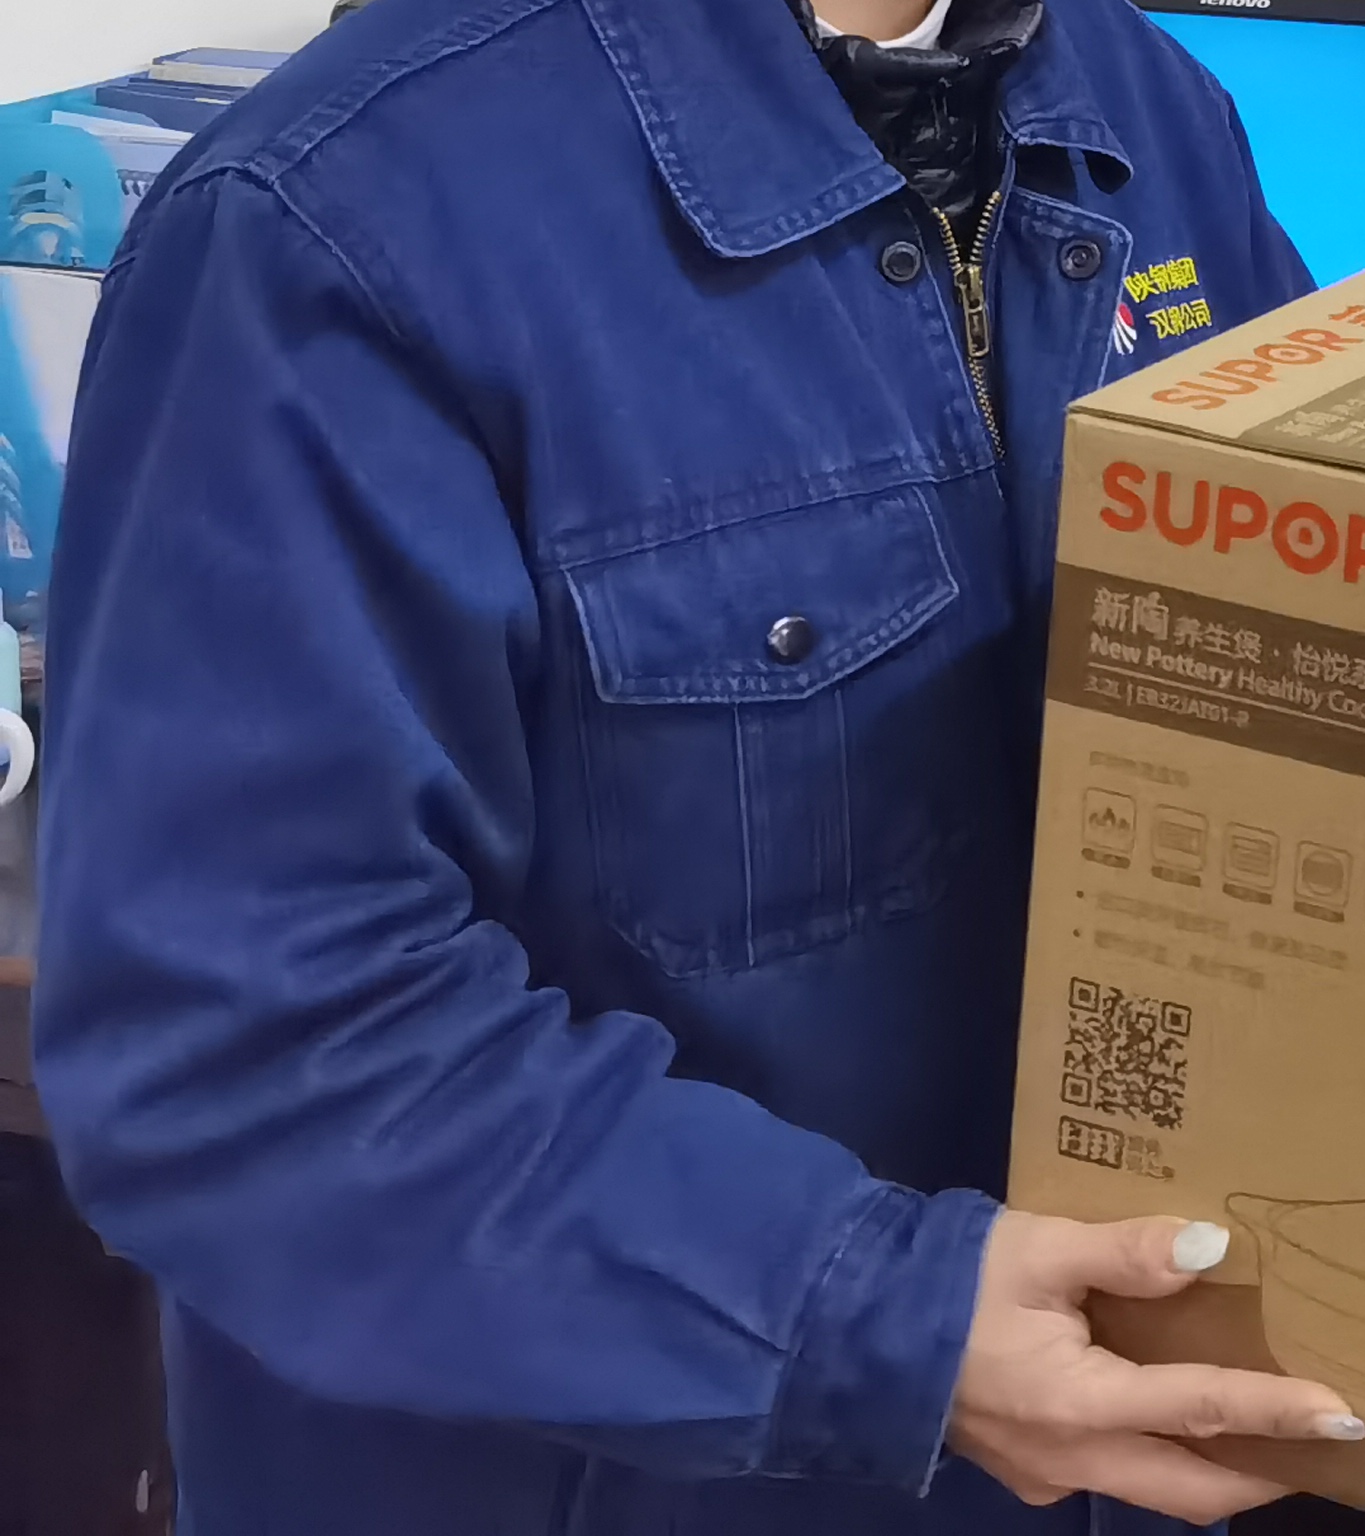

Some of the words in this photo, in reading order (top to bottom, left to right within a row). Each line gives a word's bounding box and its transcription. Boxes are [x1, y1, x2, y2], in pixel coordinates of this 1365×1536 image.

[1151, 327, 1365, 411] SUPOR
[1090, 631, 1142, 665] New
[1145, 644, 1234, 690] Pottery
[1237, 667, 1323, 712] Healthy
